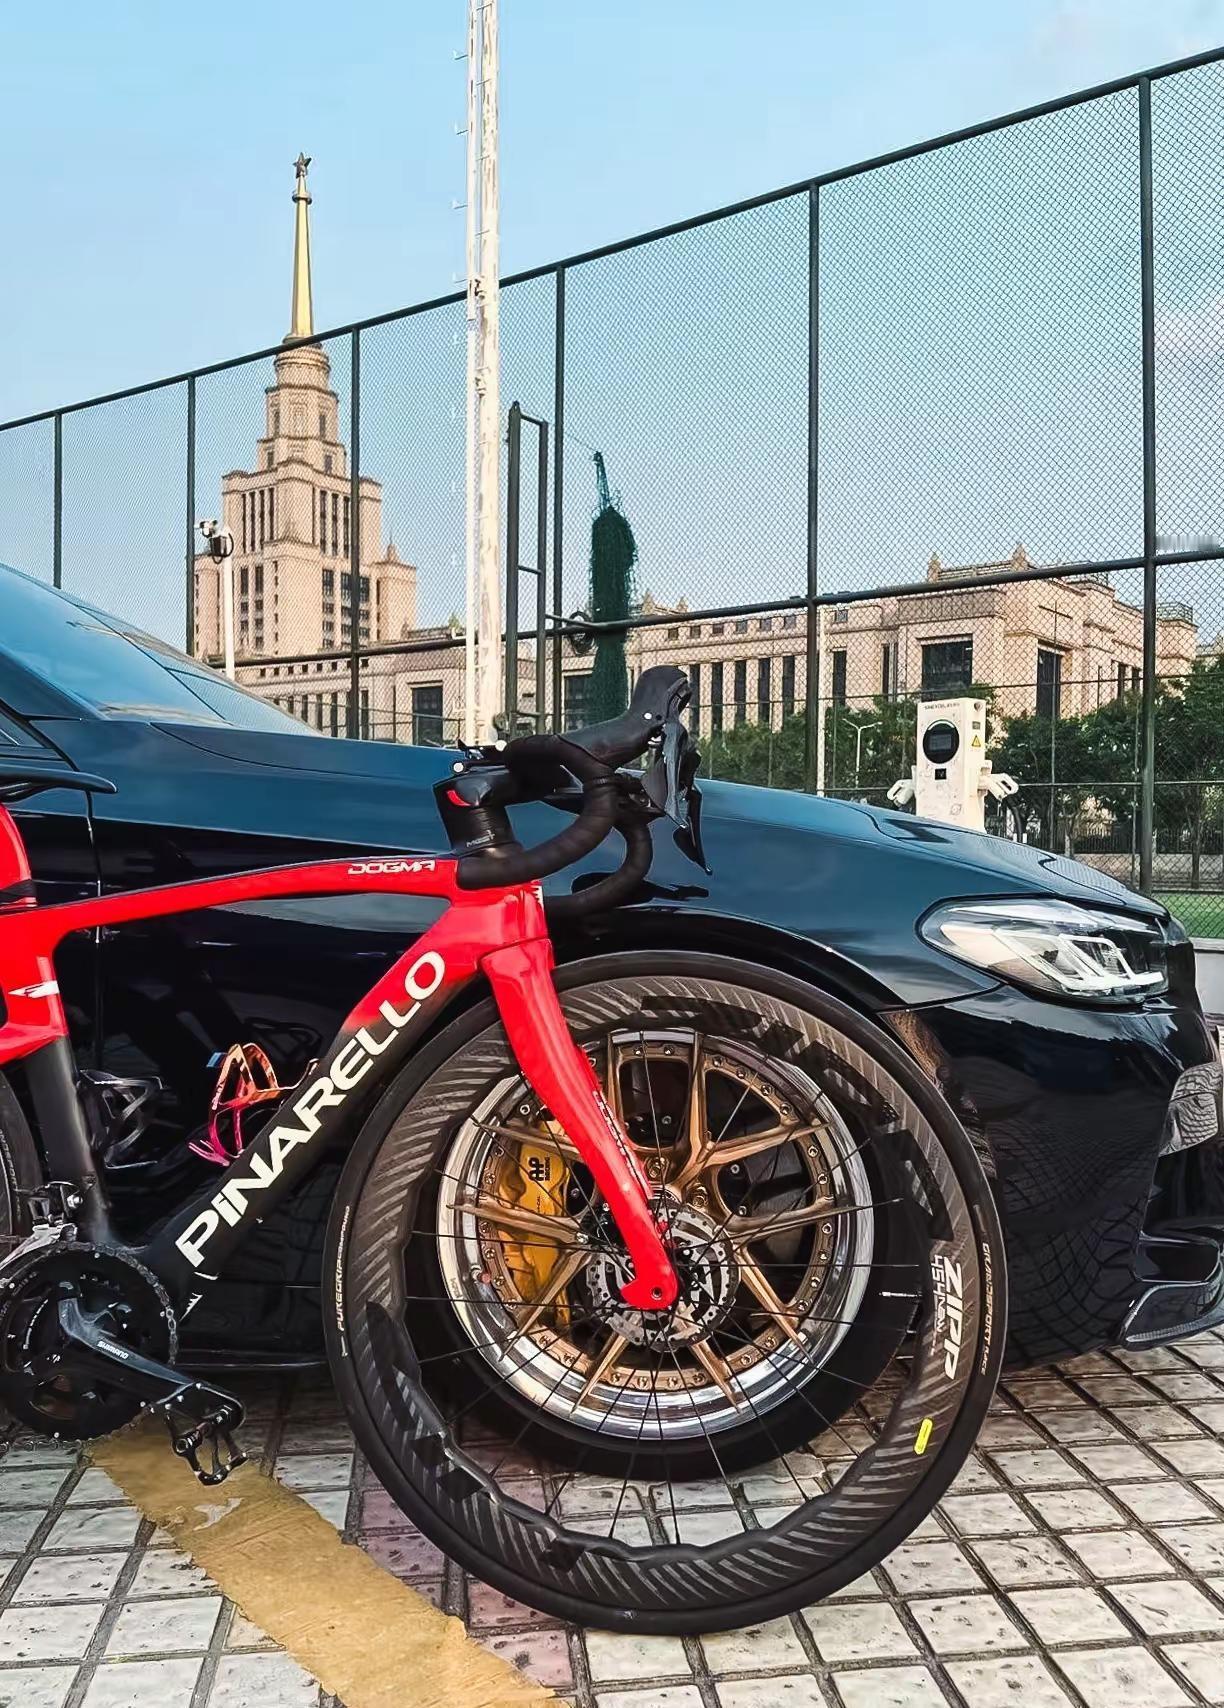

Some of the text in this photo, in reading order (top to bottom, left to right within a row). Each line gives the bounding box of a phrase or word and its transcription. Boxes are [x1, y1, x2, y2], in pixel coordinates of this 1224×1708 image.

[347, 860, 435, 875] DOGMA
[175, 950, 446, 1268] PINARELLO
[528, 1156, 545, 1182] AP
[943, 1256, 964, 1381] ZIPP
[982, 1242, 994, 1346] GRANDSPORT
[97, 1340, 130, 1360] SHIMANO
